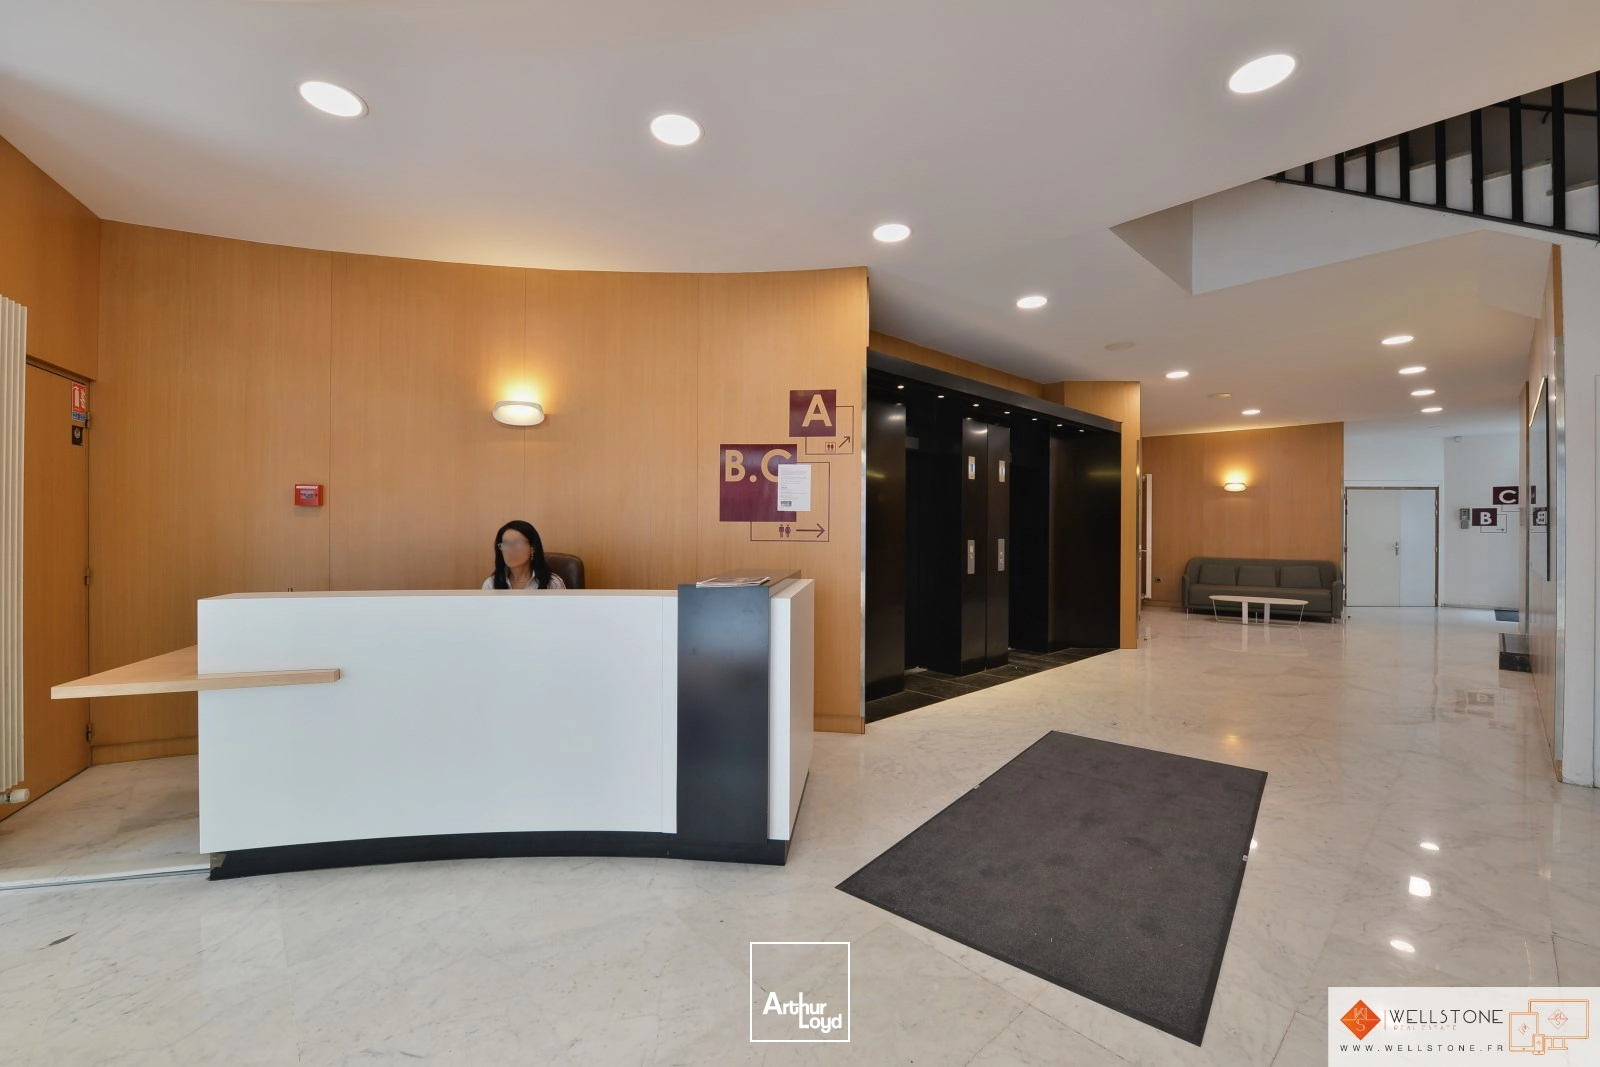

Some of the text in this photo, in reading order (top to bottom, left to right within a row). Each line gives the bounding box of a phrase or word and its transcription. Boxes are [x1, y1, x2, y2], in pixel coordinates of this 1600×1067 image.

[802, 394, 833, 427] A
[725, 448, 793, 483] B.C
[1498, 489, 1517, 504] C
[1480, 511, 1492, 525] B
